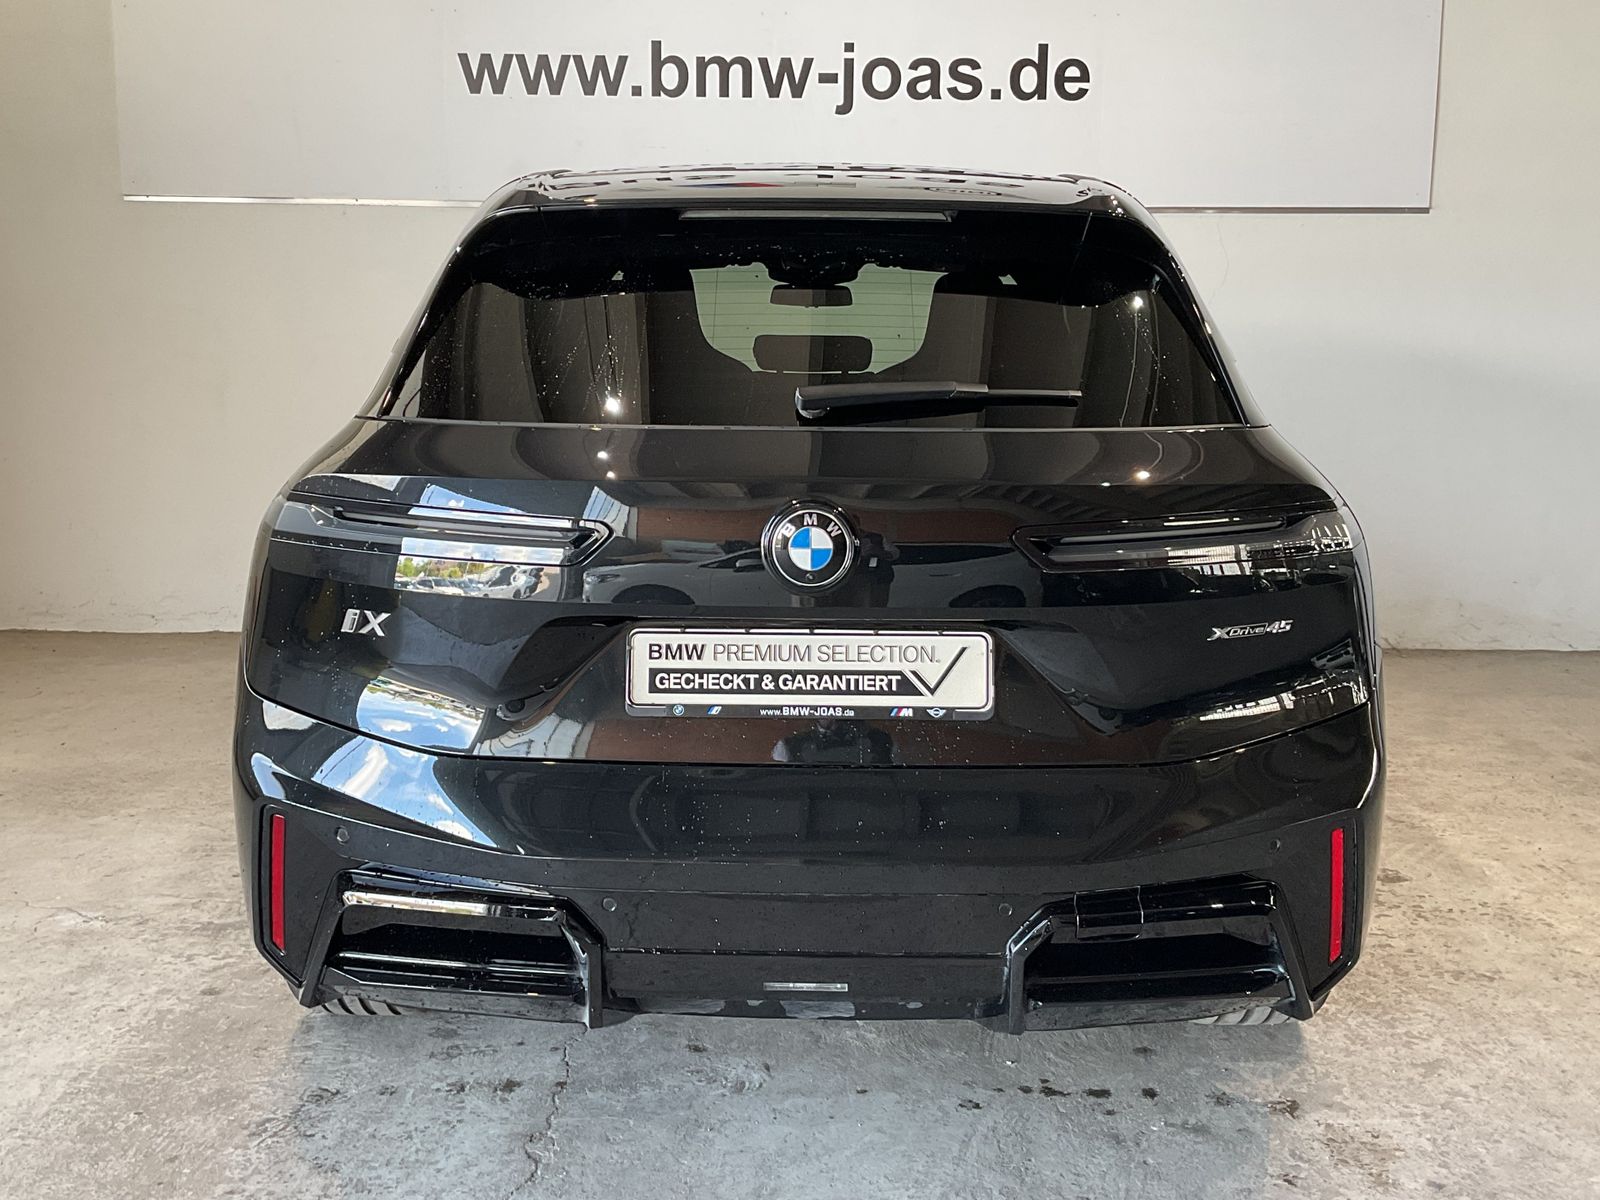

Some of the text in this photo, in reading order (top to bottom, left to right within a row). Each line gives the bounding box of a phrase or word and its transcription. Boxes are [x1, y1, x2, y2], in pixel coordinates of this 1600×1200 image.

[457, 40, 1091, 115] www.bmw-joas.de
[780, 513, 842, 538] BMW
[341, 609, 391, 636] iX
[649, 644, 706, 660] BMW
[713, 644, 812, 662] PREMIUM
[655, 673, 901, 691] GECHECKT & GARANTIERT
